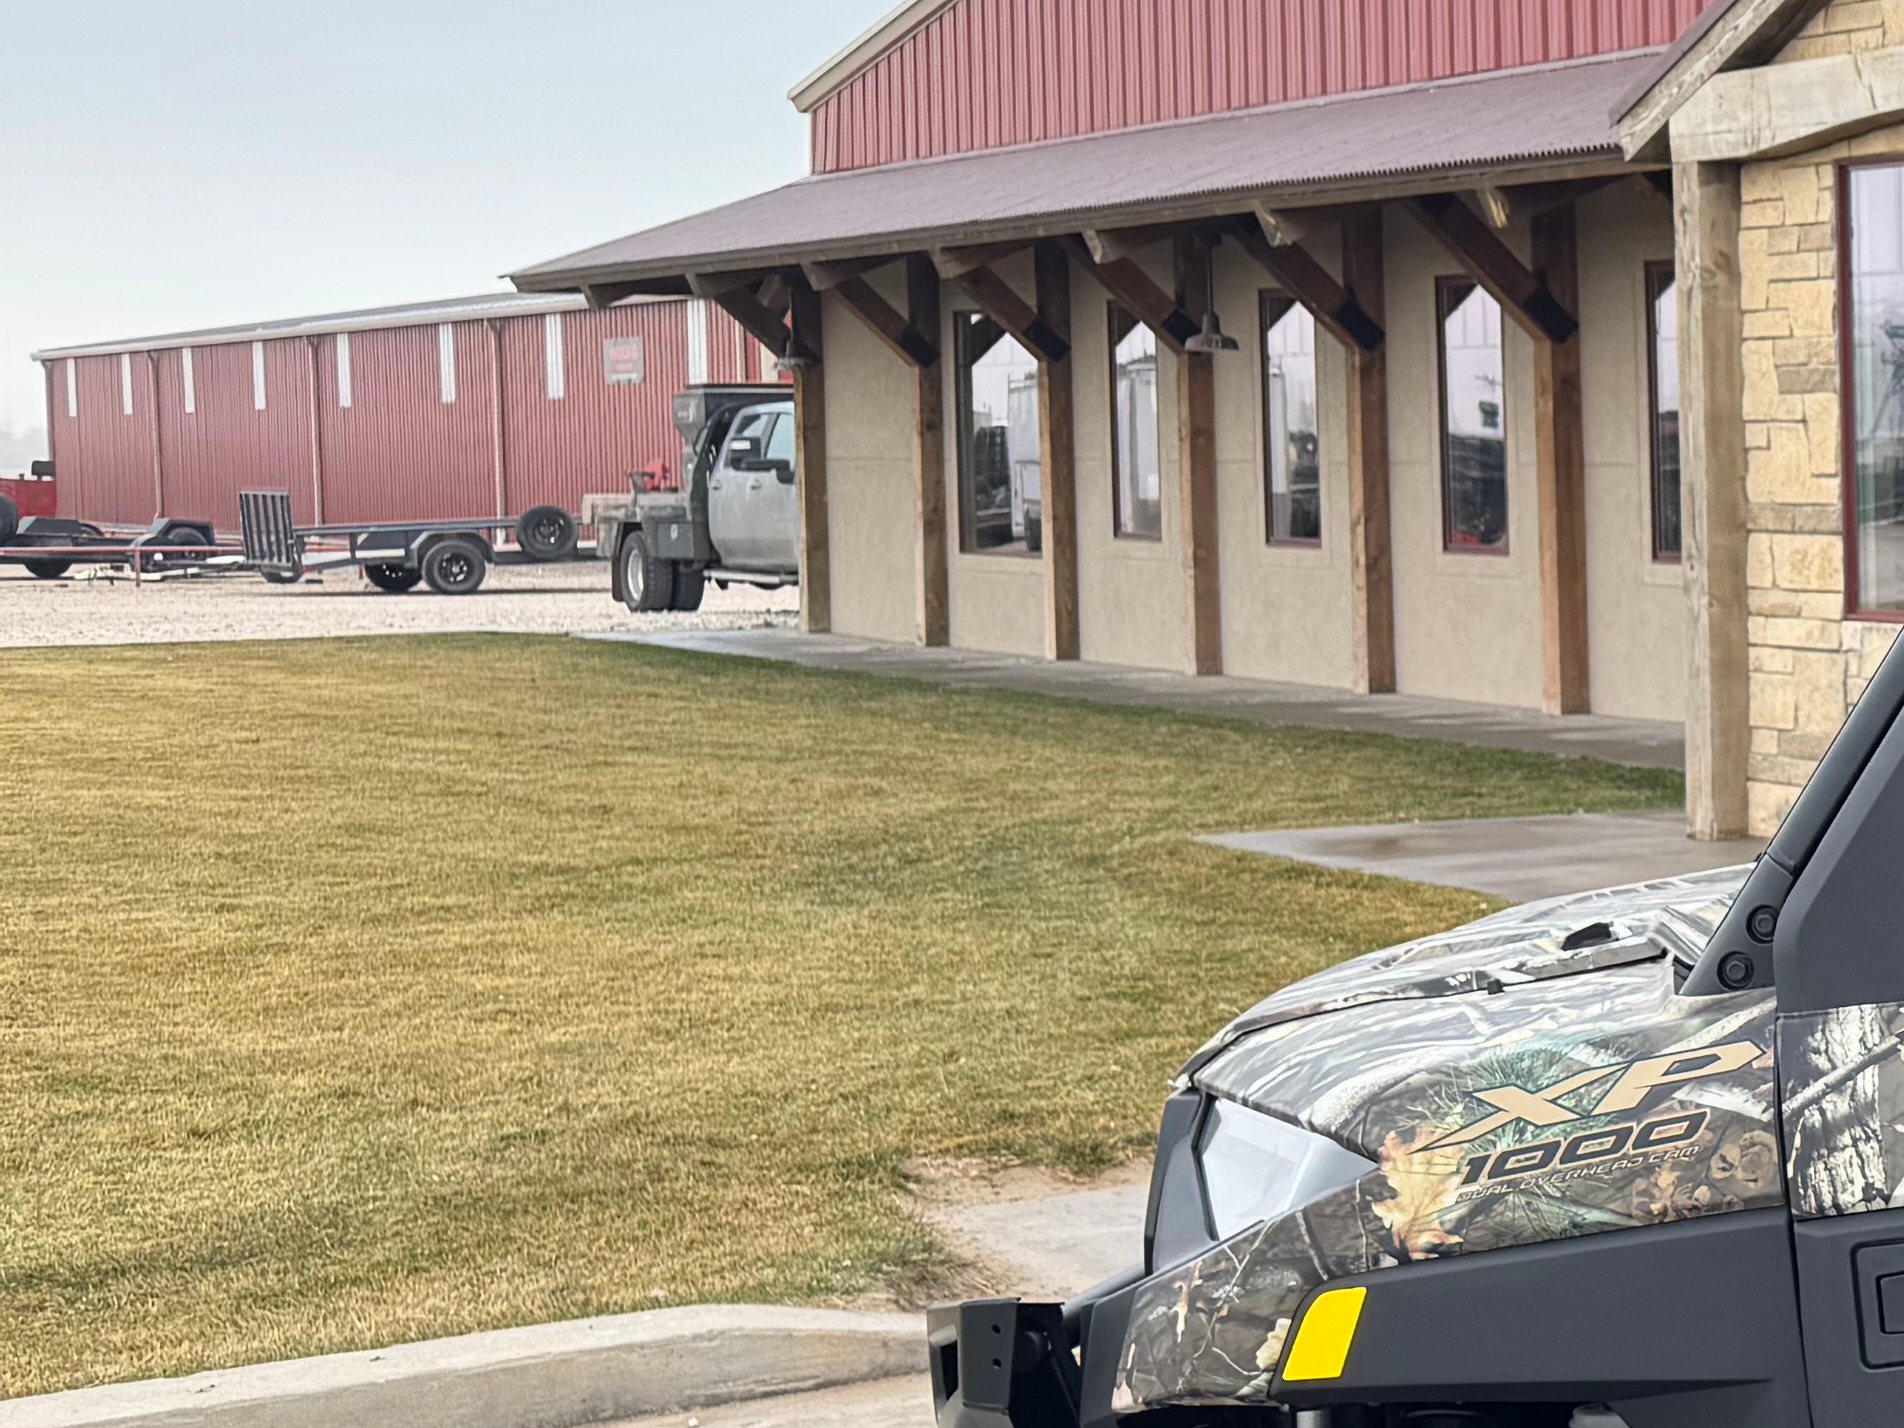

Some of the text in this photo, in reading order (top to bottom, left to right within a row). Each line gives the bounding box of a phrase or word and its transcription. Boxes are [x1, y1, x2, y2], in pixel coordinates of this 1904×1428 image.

[1406, 1039, 1768, 1155] XP
[1455, 1145, 1700, 1205] DUAL OVERHEAD CAM
[1459, 1107, 1711, 1188] 1000
